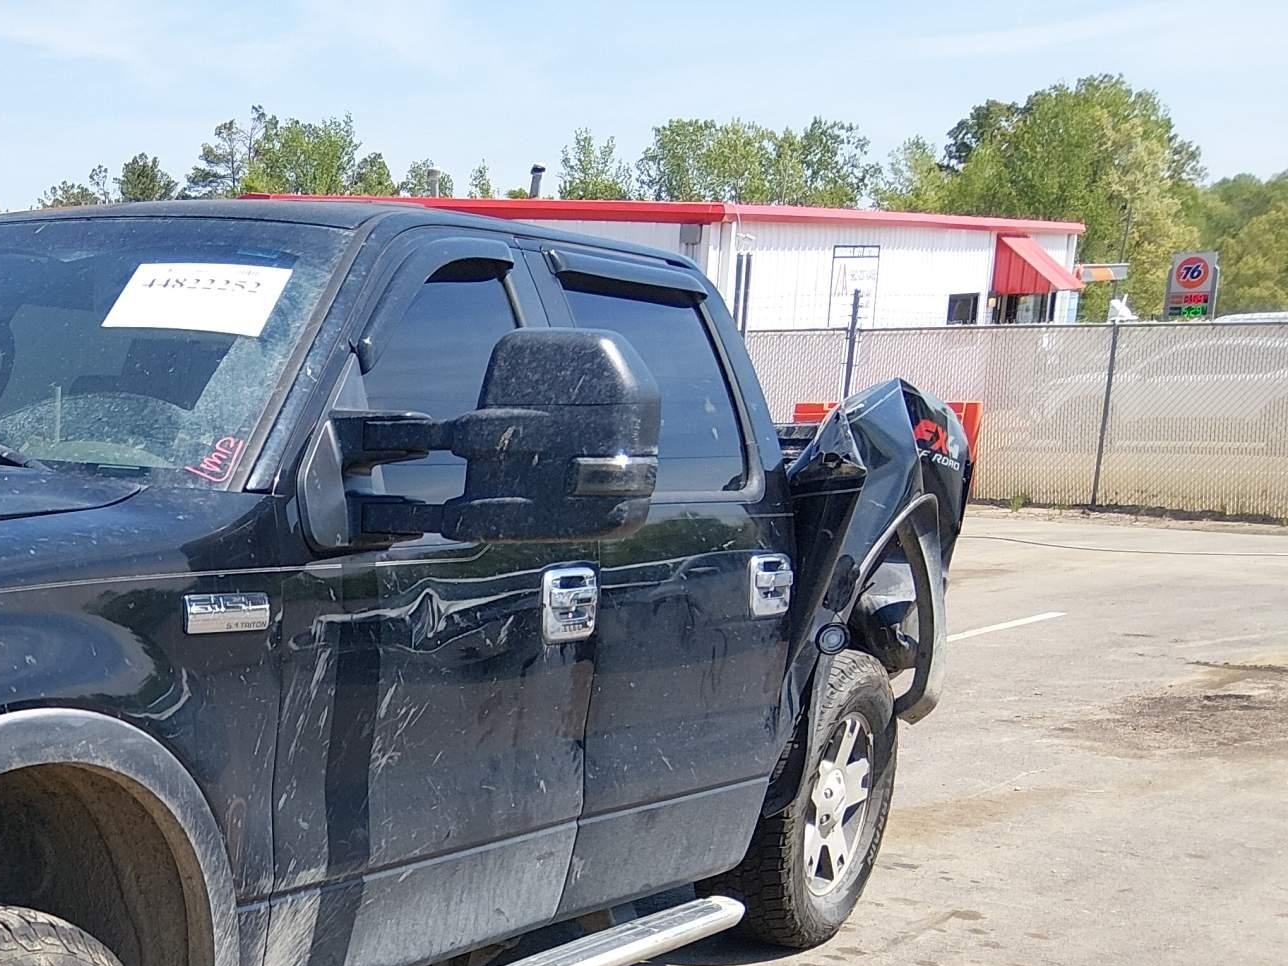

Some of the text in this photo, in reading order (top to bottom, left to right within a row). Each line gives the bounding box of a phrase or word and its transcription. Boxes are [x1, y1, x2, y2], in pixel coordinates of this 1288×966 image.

[1181, 263, 1203, 280] 76
[142, 278, 261, 293] 44822252
[932, 453, 960, 471] ROAD
[240, 620, 267, 629] TRITON
